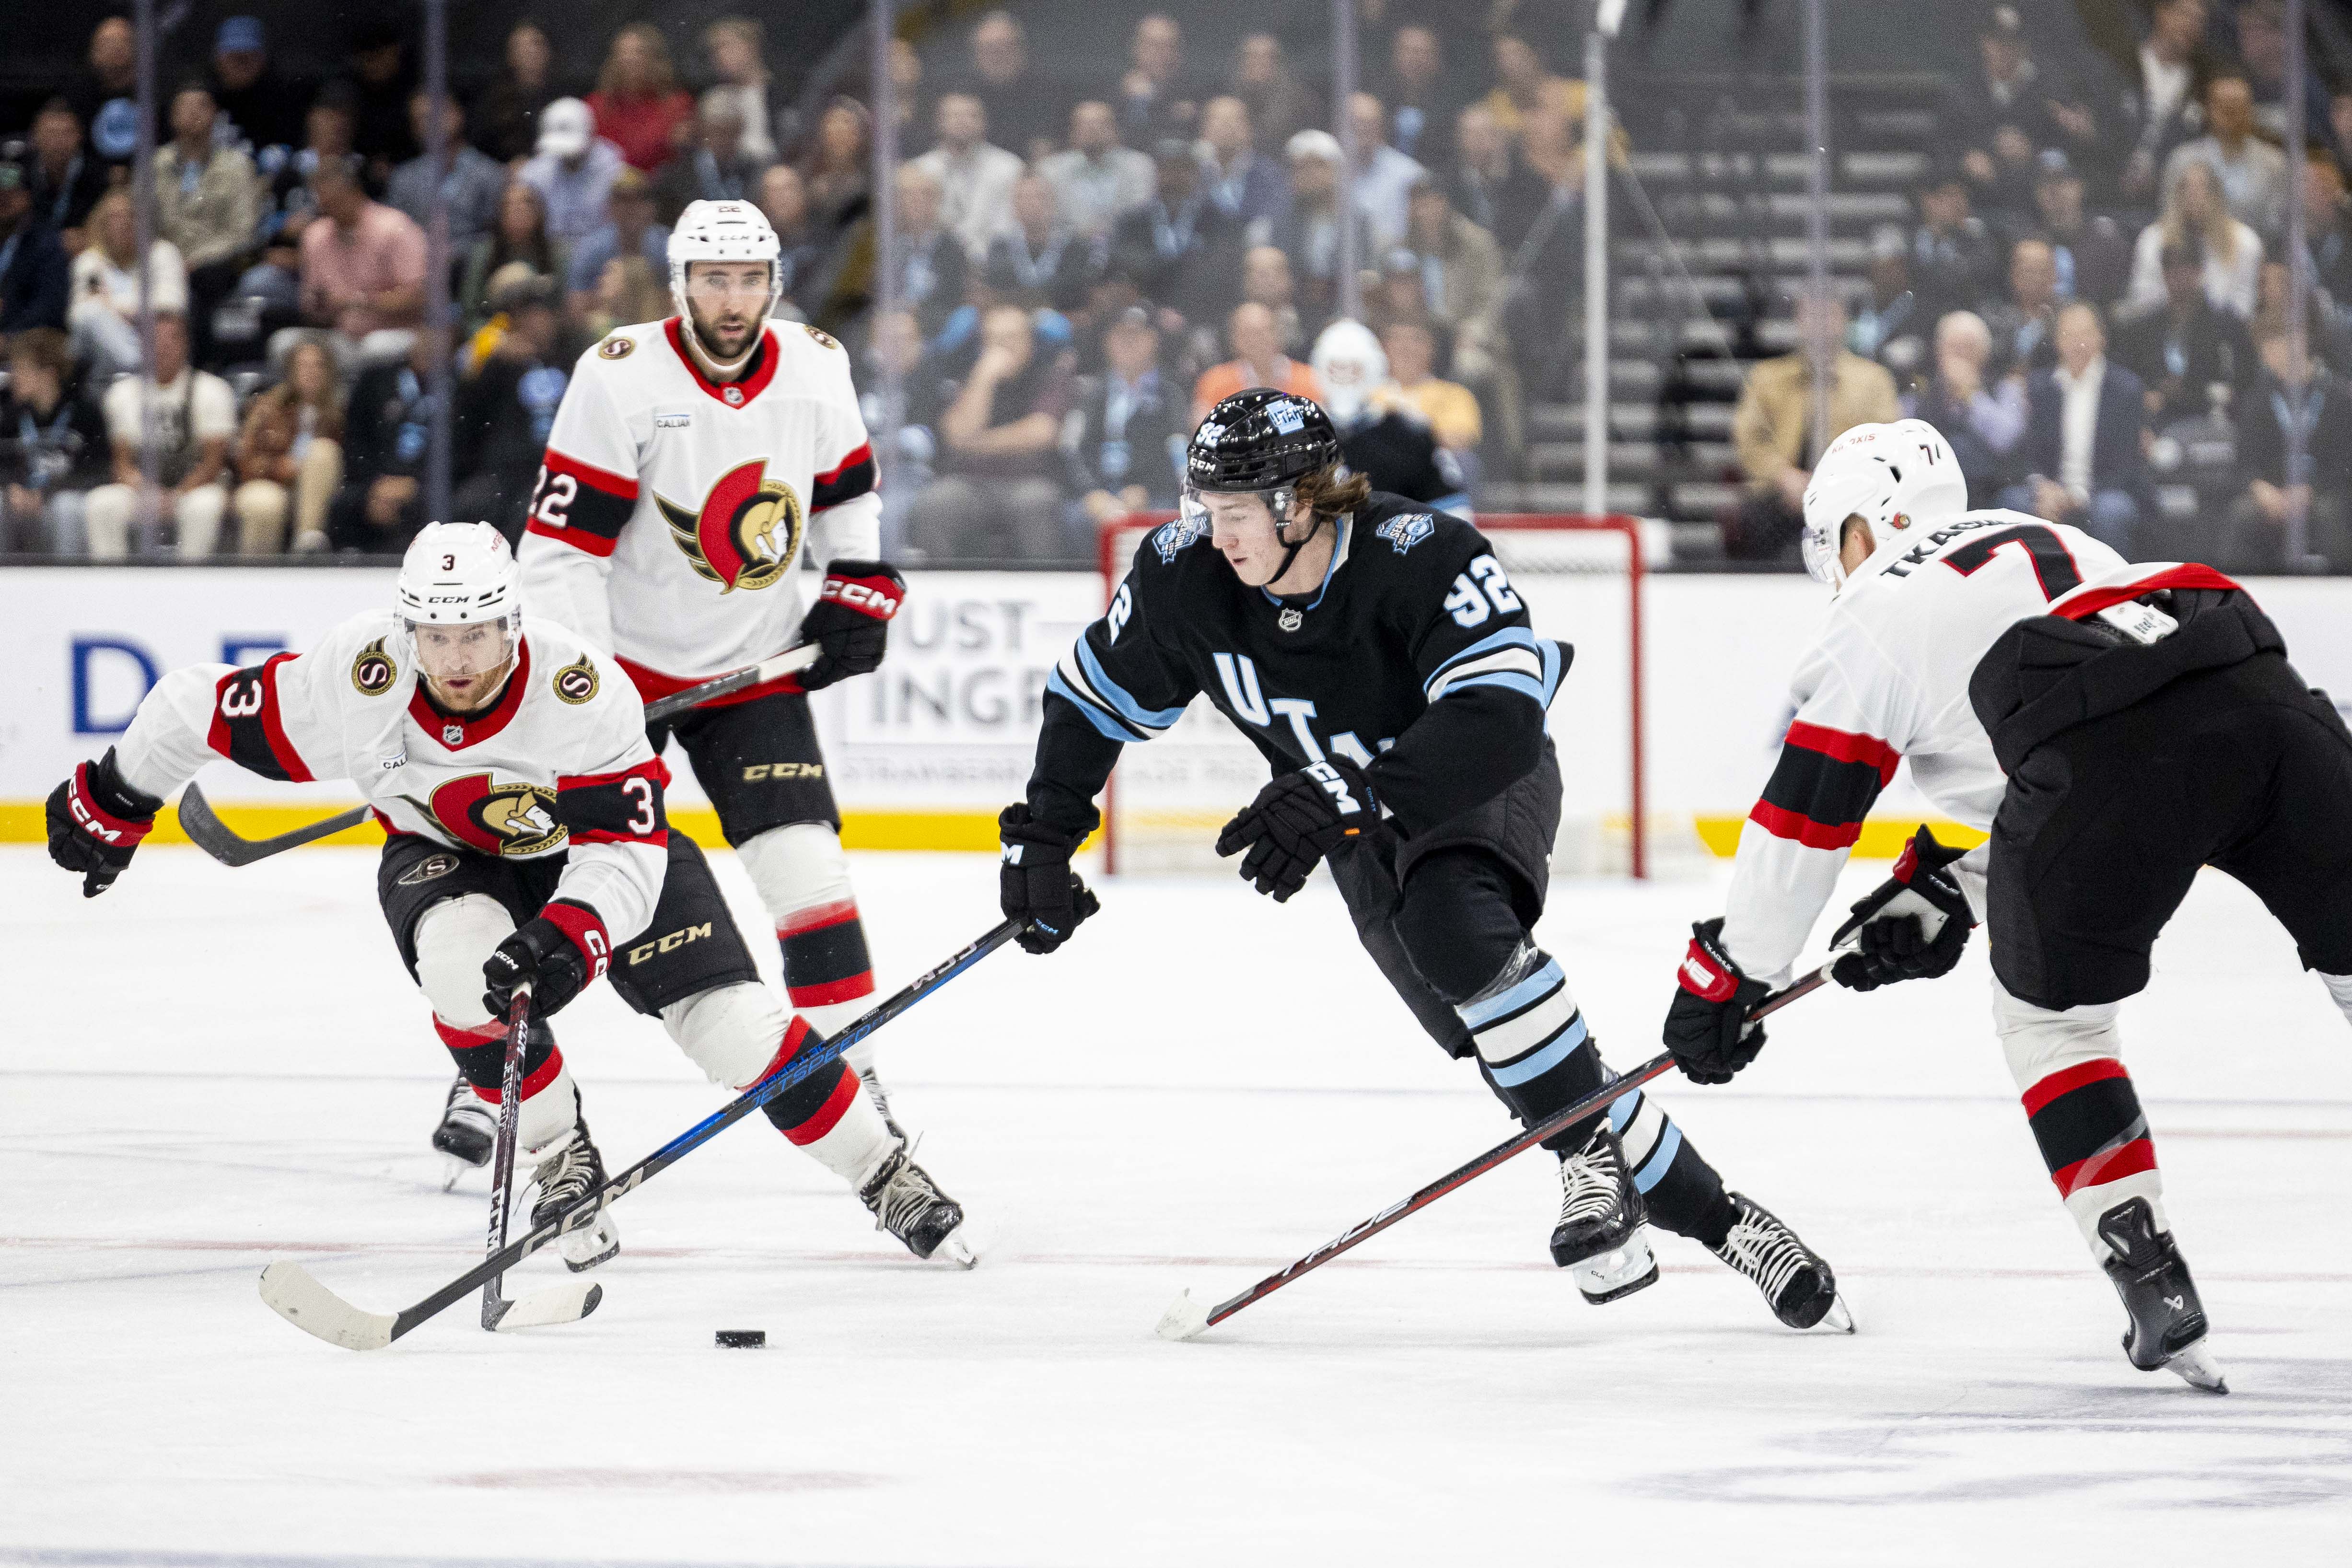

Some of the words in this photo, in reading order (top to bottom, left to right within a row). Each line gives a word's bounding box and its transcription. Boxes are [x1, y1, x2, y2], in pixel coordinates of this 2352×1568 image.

[1196, 422, 1225, 448] 92
[1189, 456, 1216, 473] CCM
[1919, 444, 1934, 465] 7
[442, 554, 455, 571] 3
[1939, 523, 2085, 604] 7
[821, 580, 897, 614] CCM
[1443, 554, 1523, 628] 92
[1284, 616, 1298, 625] NHL
[359, 663, 387, 685] S
[562, 672, 591, 697] S
[221, 679, 263, 717] 3
[743, 763, 822, 780] CCM
[69, 774, 122, 843] CCM
[623, 777, 655, 834] 3
[494, 950, 519, 970] CCM
[627, 922, 712, 966] CCM
[517, 1018, 528, 1058] CCM
[743, 1023, 872, 1115] JETSPEED
[500, 1060, 514, 1127] JETSPEED
[520, 1166, 644, 1260] CCM
